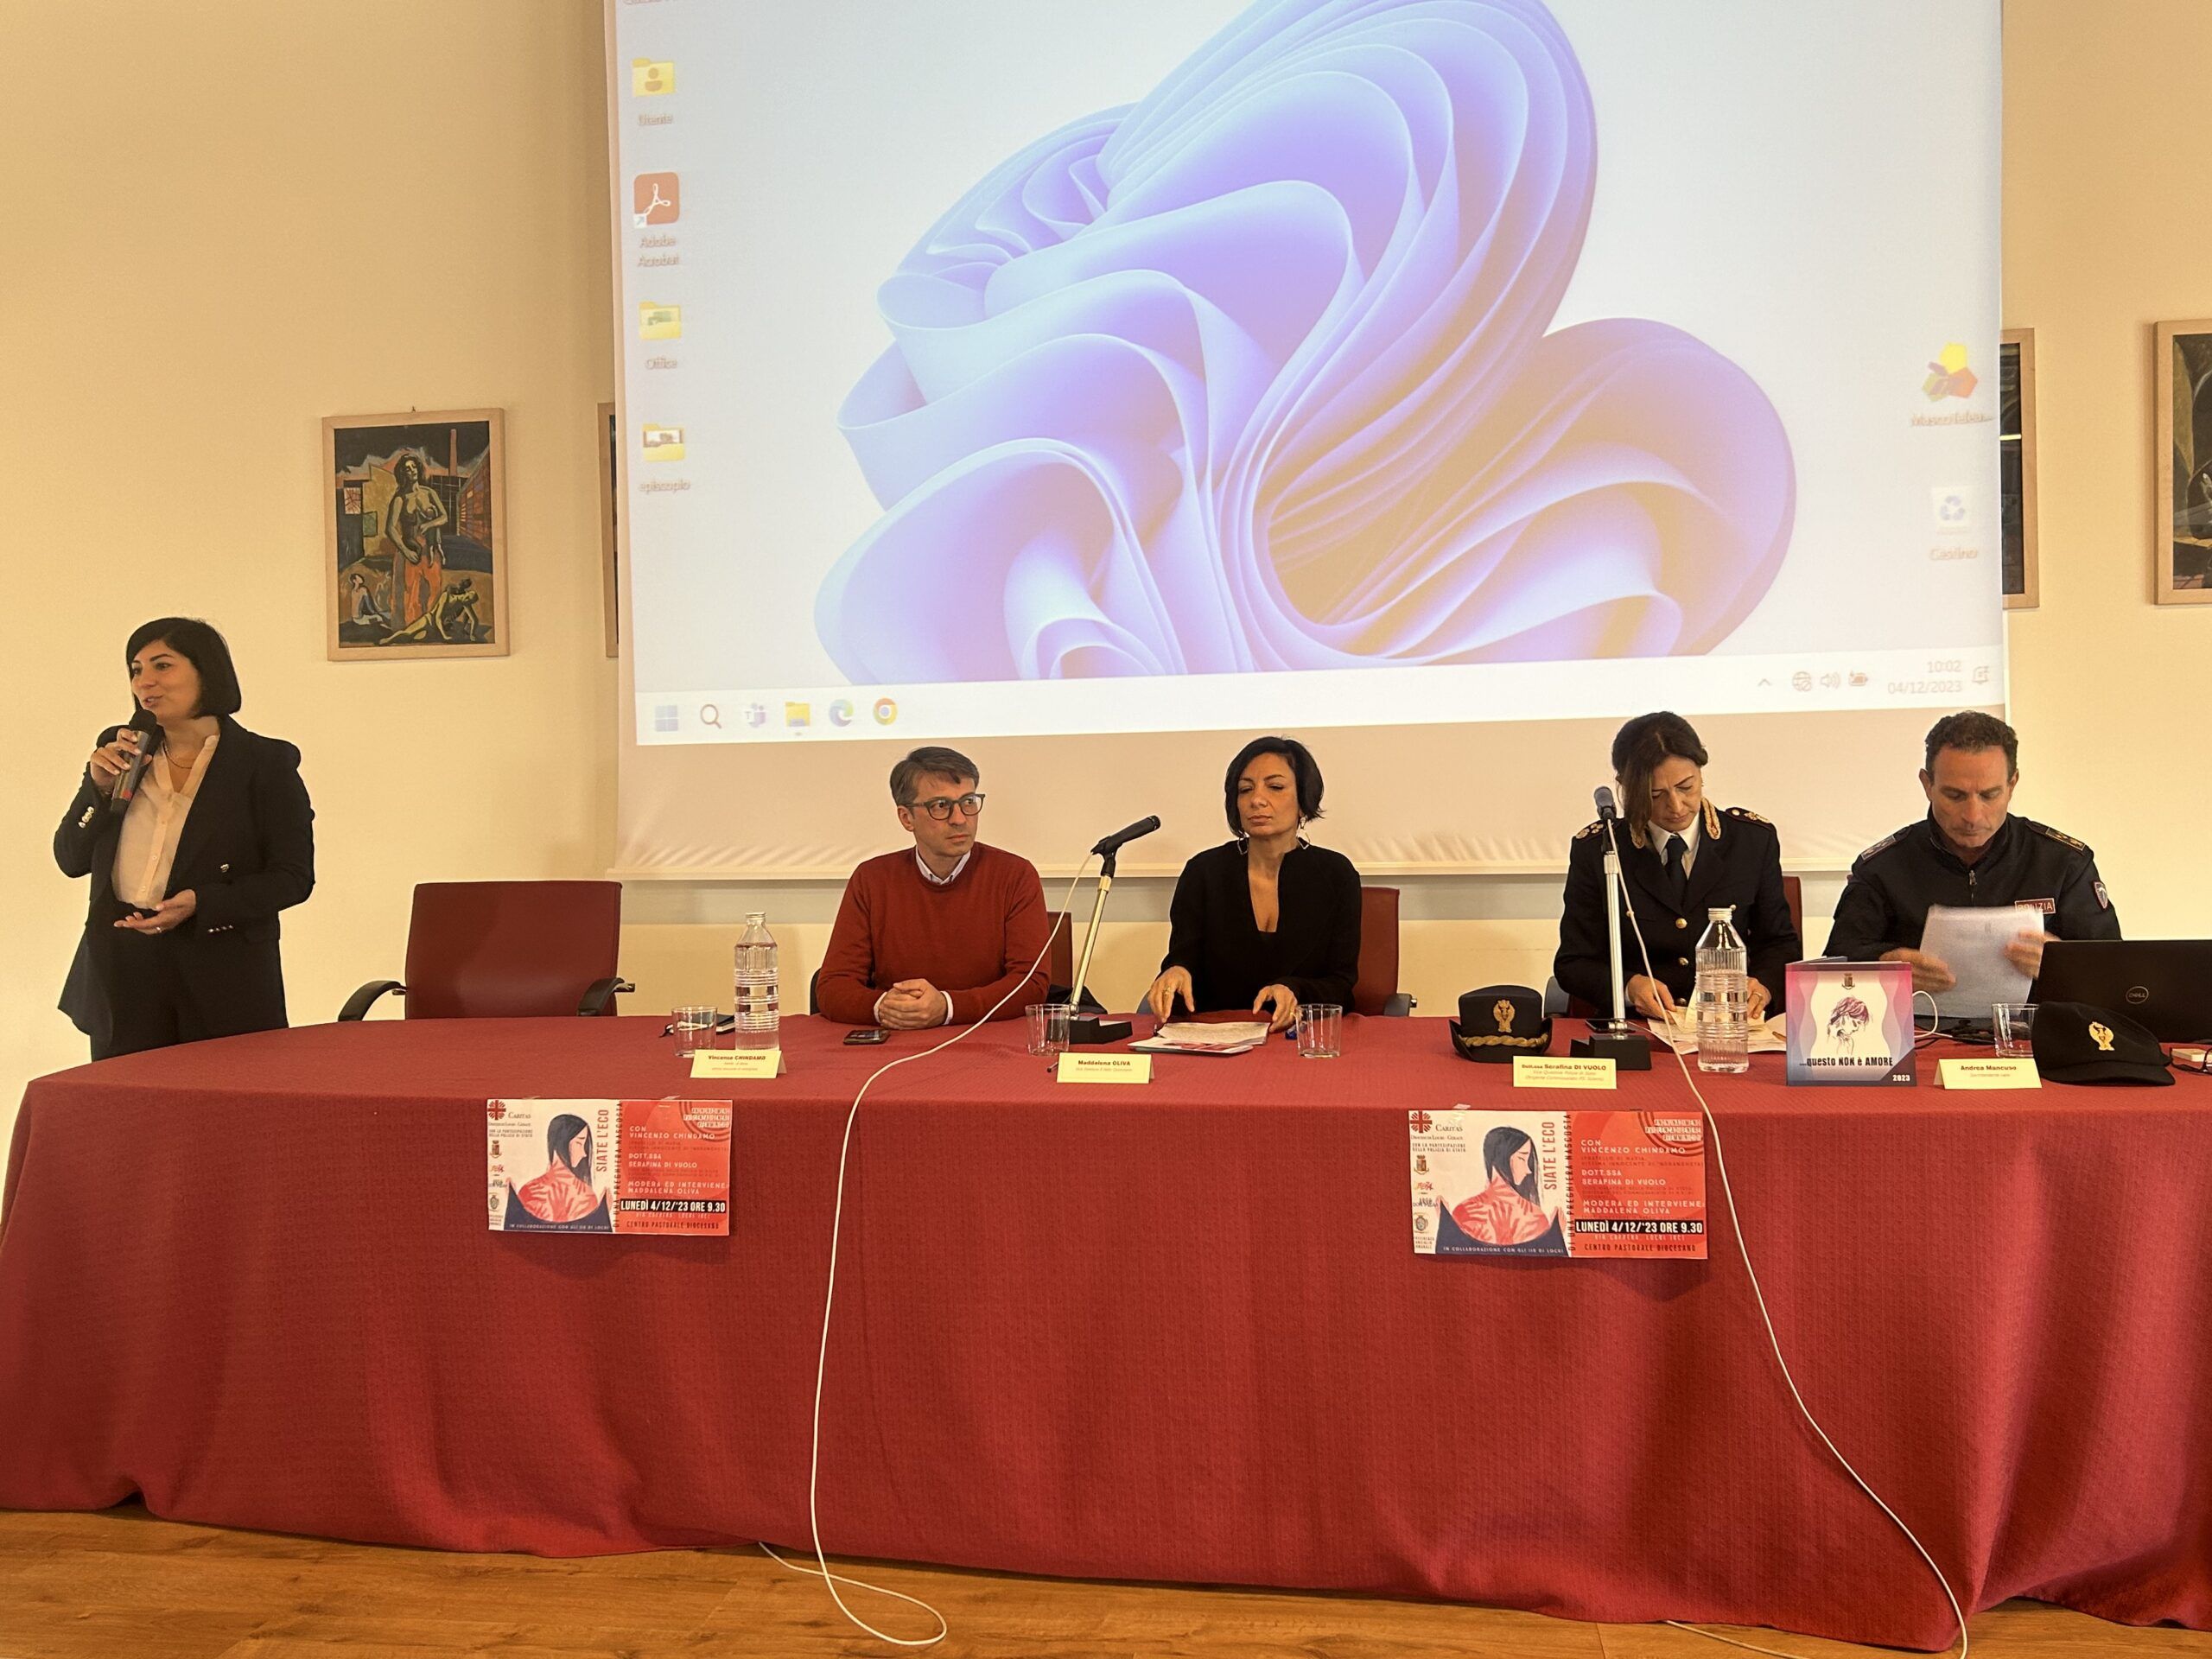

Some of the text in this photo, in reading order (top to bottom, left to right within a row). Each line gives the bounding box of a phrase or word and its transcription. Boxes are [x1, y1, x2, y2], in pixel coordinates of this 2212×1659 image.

[639, 235, 677, 248] Adobe
[645, 356, 678, 370] Office
[1927, 660, 1962, 673] 10:02
[1888, 681, 1962, 695] 04/12/2023
[1839, 1058, 1855, 1066] NON
[1858, 1057, 1862, 1066] è
[1865, 1057, 1893, 1066] AMORE
[596, 1109, 609, 1172] SIATE L'ECO
[1541, 1122, 1557, 1190] SIATE L'ECO
[614, 1150, 622, 1195] PREGHIERA
[1564, 1114, 1576, 1251] DI UNA PREGHIERA NASCOSTA
[621, 1199, 648, 1210] LUNEDÌ
[690, 1202, 705, 1212] ORE
[707, 1202, 725, 1213] 9.30
[1576, 1220, 1609, 1233] LUNEDÌ
[1660, 1222, 1678, 1233] ORE
[1680, 1223, 1703, 1233] 9.30
